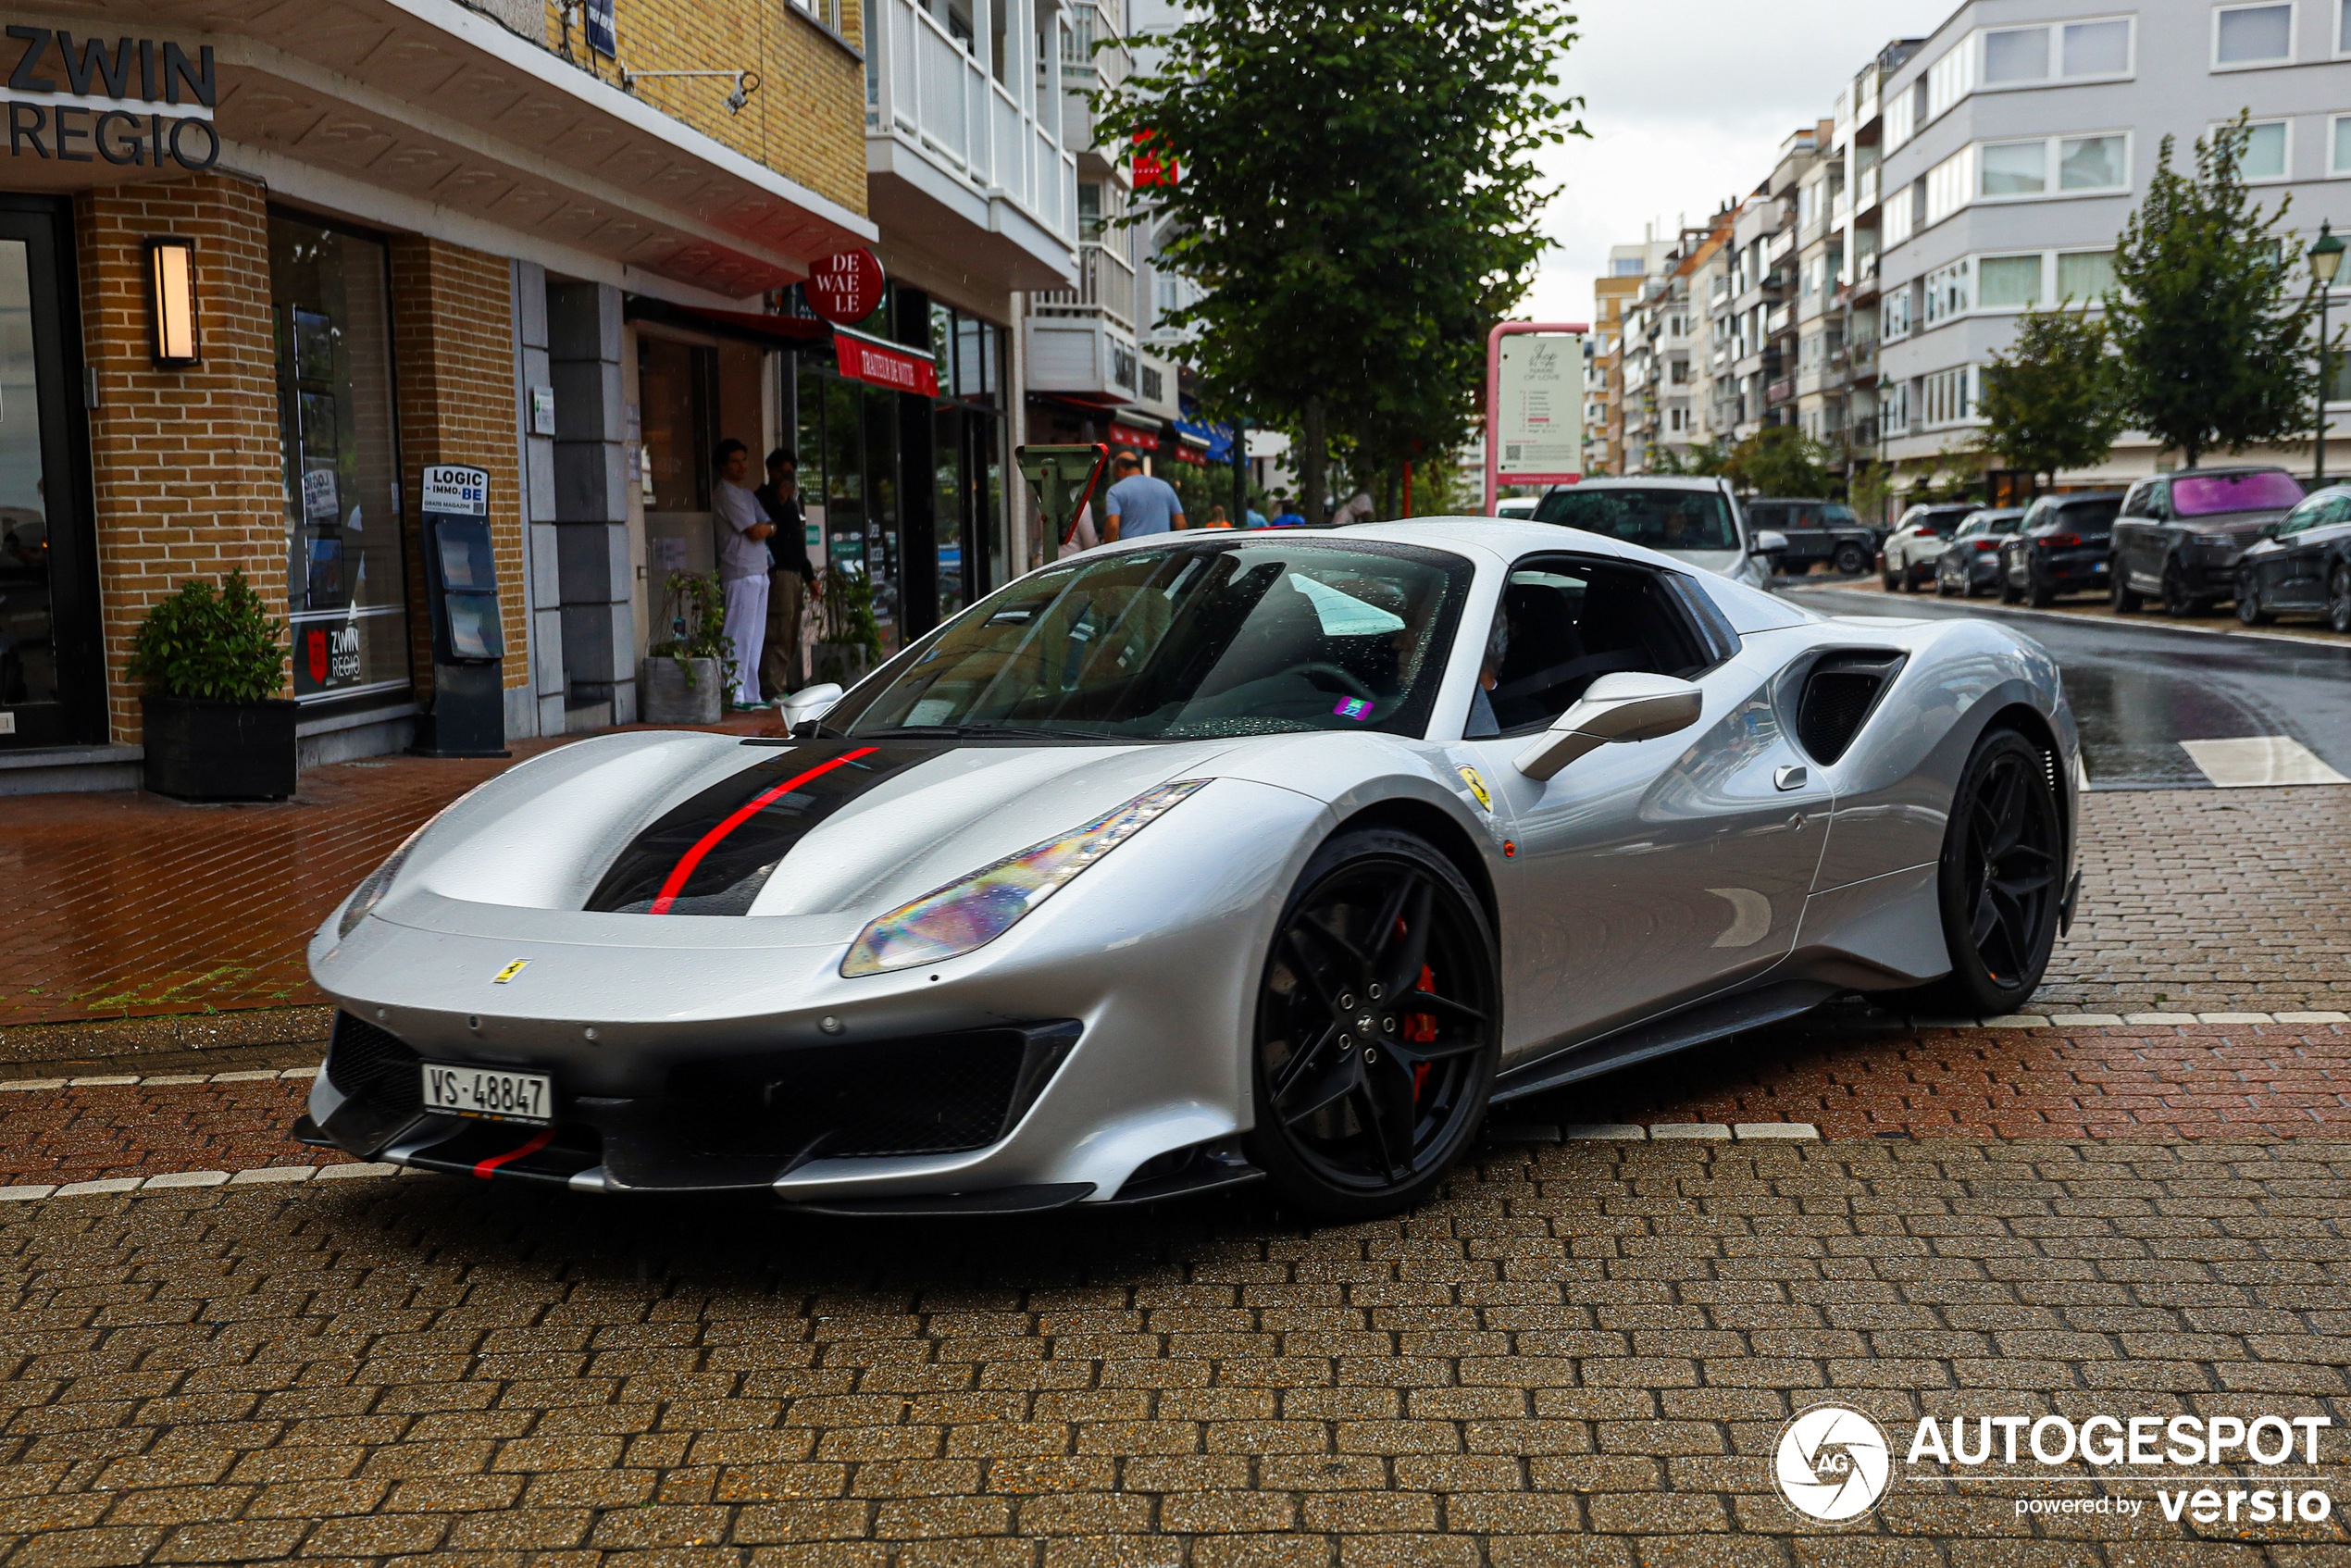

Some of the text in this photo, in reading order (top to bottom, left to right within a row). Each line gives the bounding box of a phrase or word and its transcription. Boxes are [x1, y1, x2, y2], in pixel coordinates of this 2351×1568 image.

[6, 25, 216, 107] ZWIN
[8, 100, 220, 170] REGIO
[833, 254, 859, 272] DE
[816, 274, 859, 292] WAE
[836, 294, 859, 312] LE
[433, 469, 482, 486] LOGIC
[330, 629, 359, 654] ZWIN
[332, 654, 361, 678] REGIO
